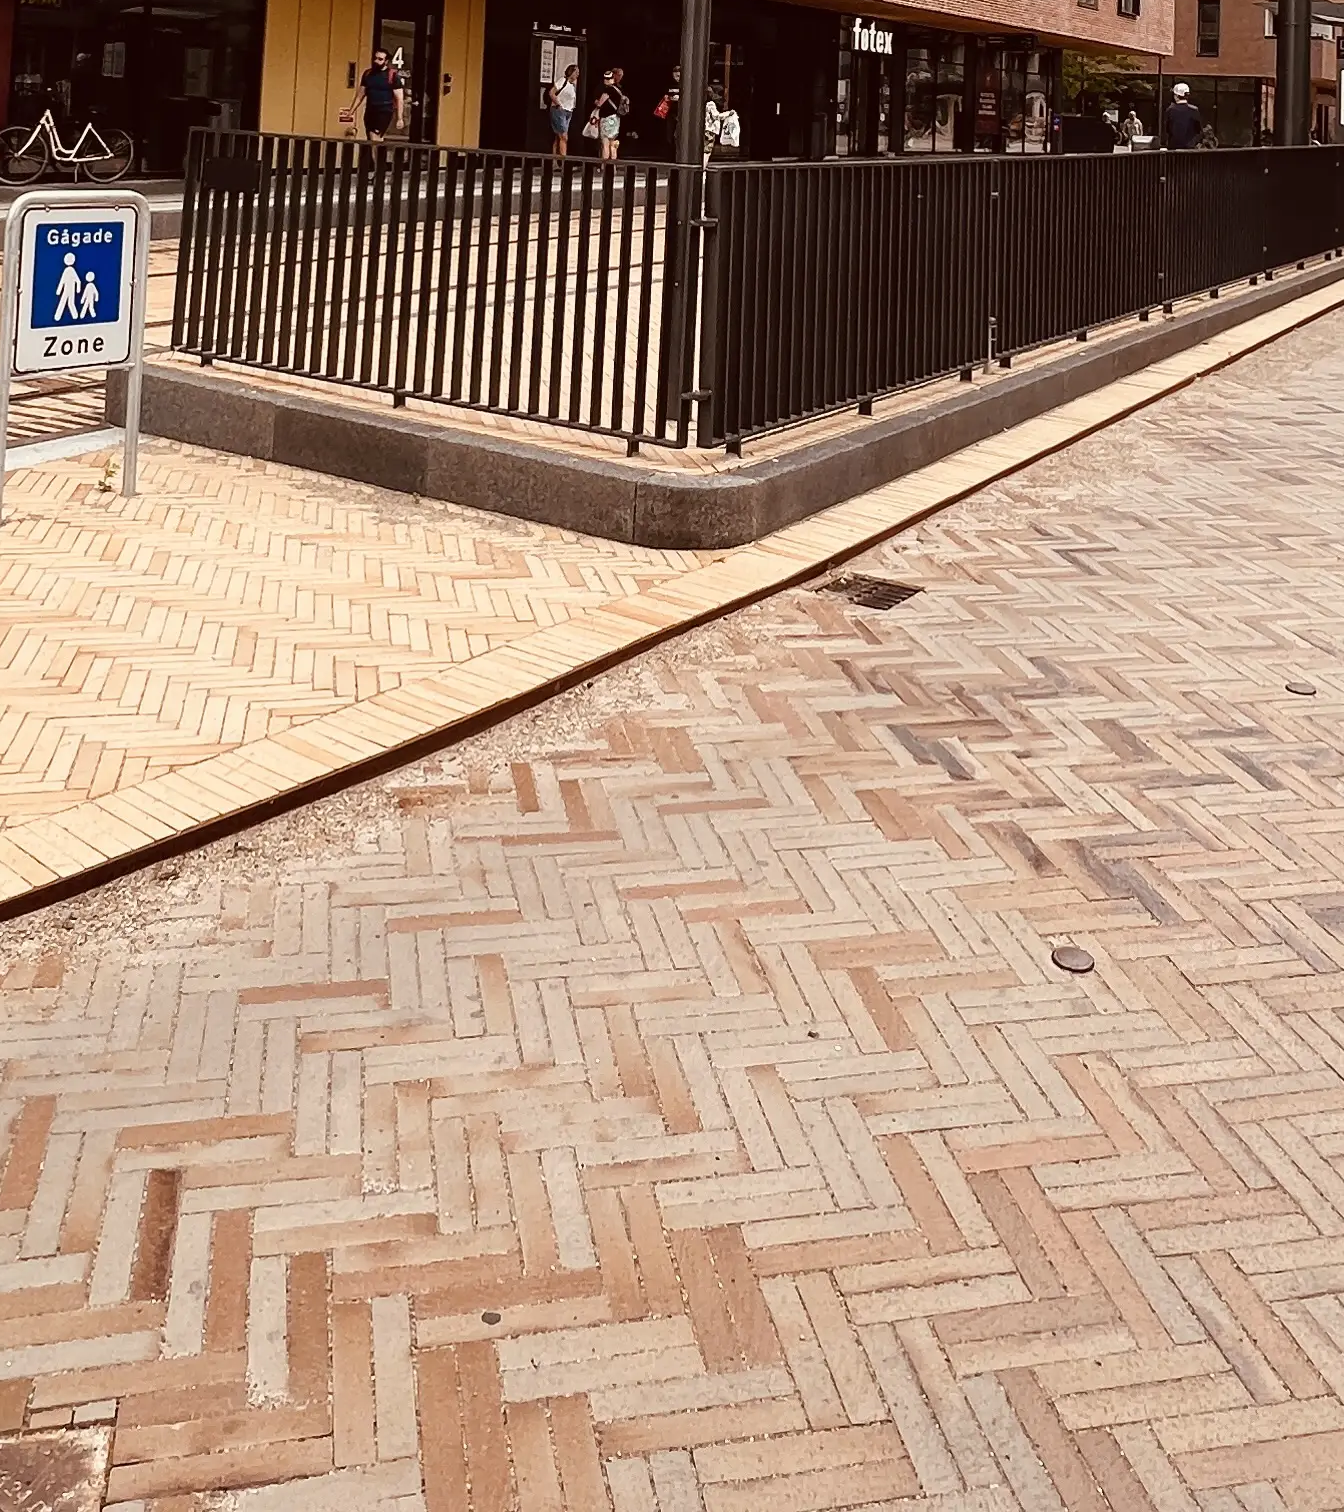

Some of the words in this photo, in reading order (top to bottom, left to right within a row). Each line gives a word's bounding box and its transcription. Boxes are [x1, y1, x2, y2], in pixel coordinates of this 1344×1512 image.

[392, 47, 404, 68] 4
[47, 228, 113, 247] Gågade
[43, 336, 105, 357] Zone
